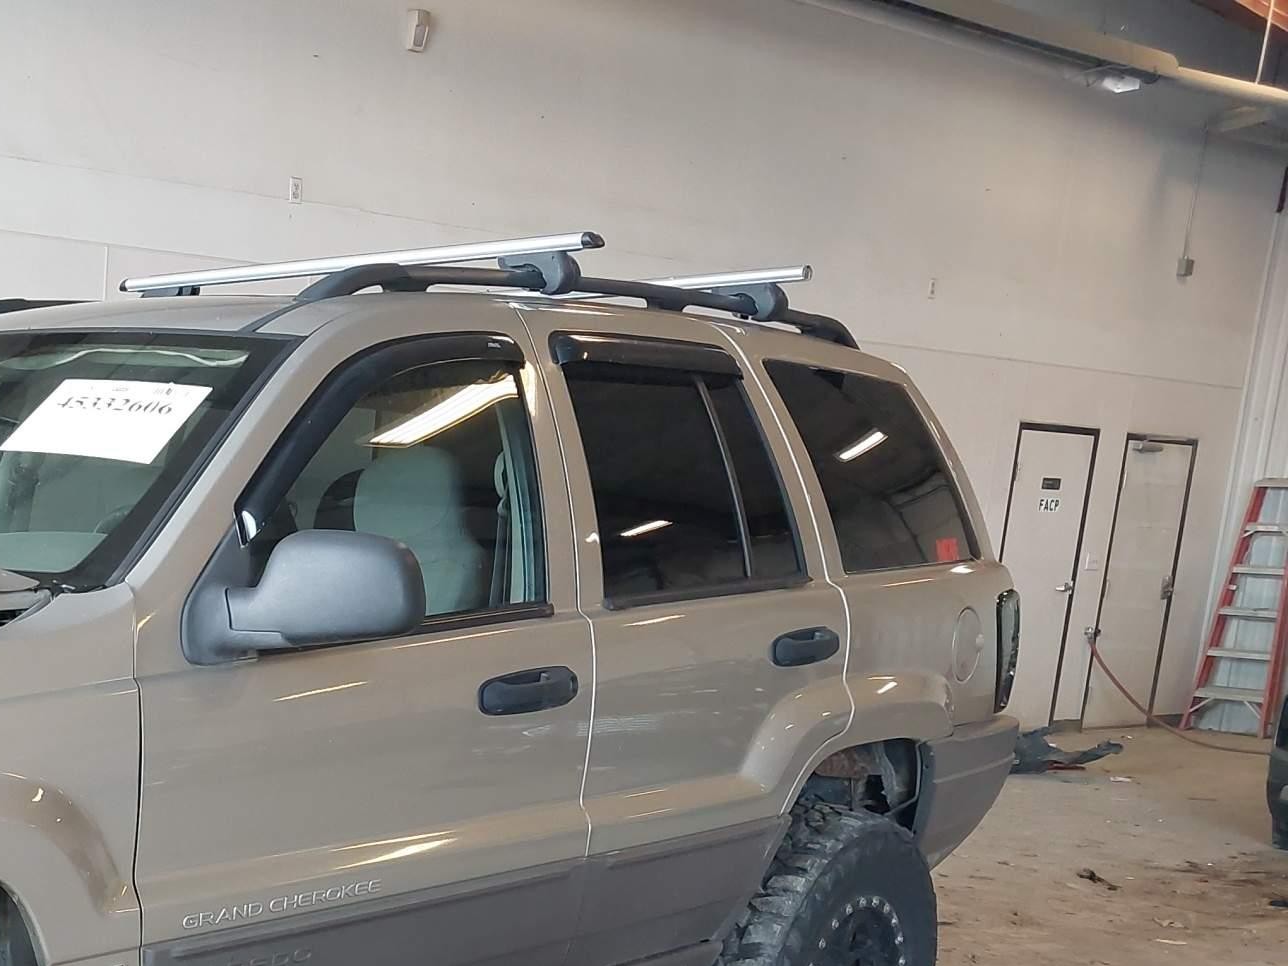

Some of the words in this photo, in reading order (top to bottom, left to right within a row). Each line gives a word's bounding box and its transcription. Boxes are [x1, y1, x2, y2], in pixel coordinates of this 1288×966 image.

[57, 396, 172, 415] 45332606
[1039, 499, 1060, 511] FACP
[182, 901, 263, 930] GRAND
[268, 878, 382, 912] CHEROKEE
